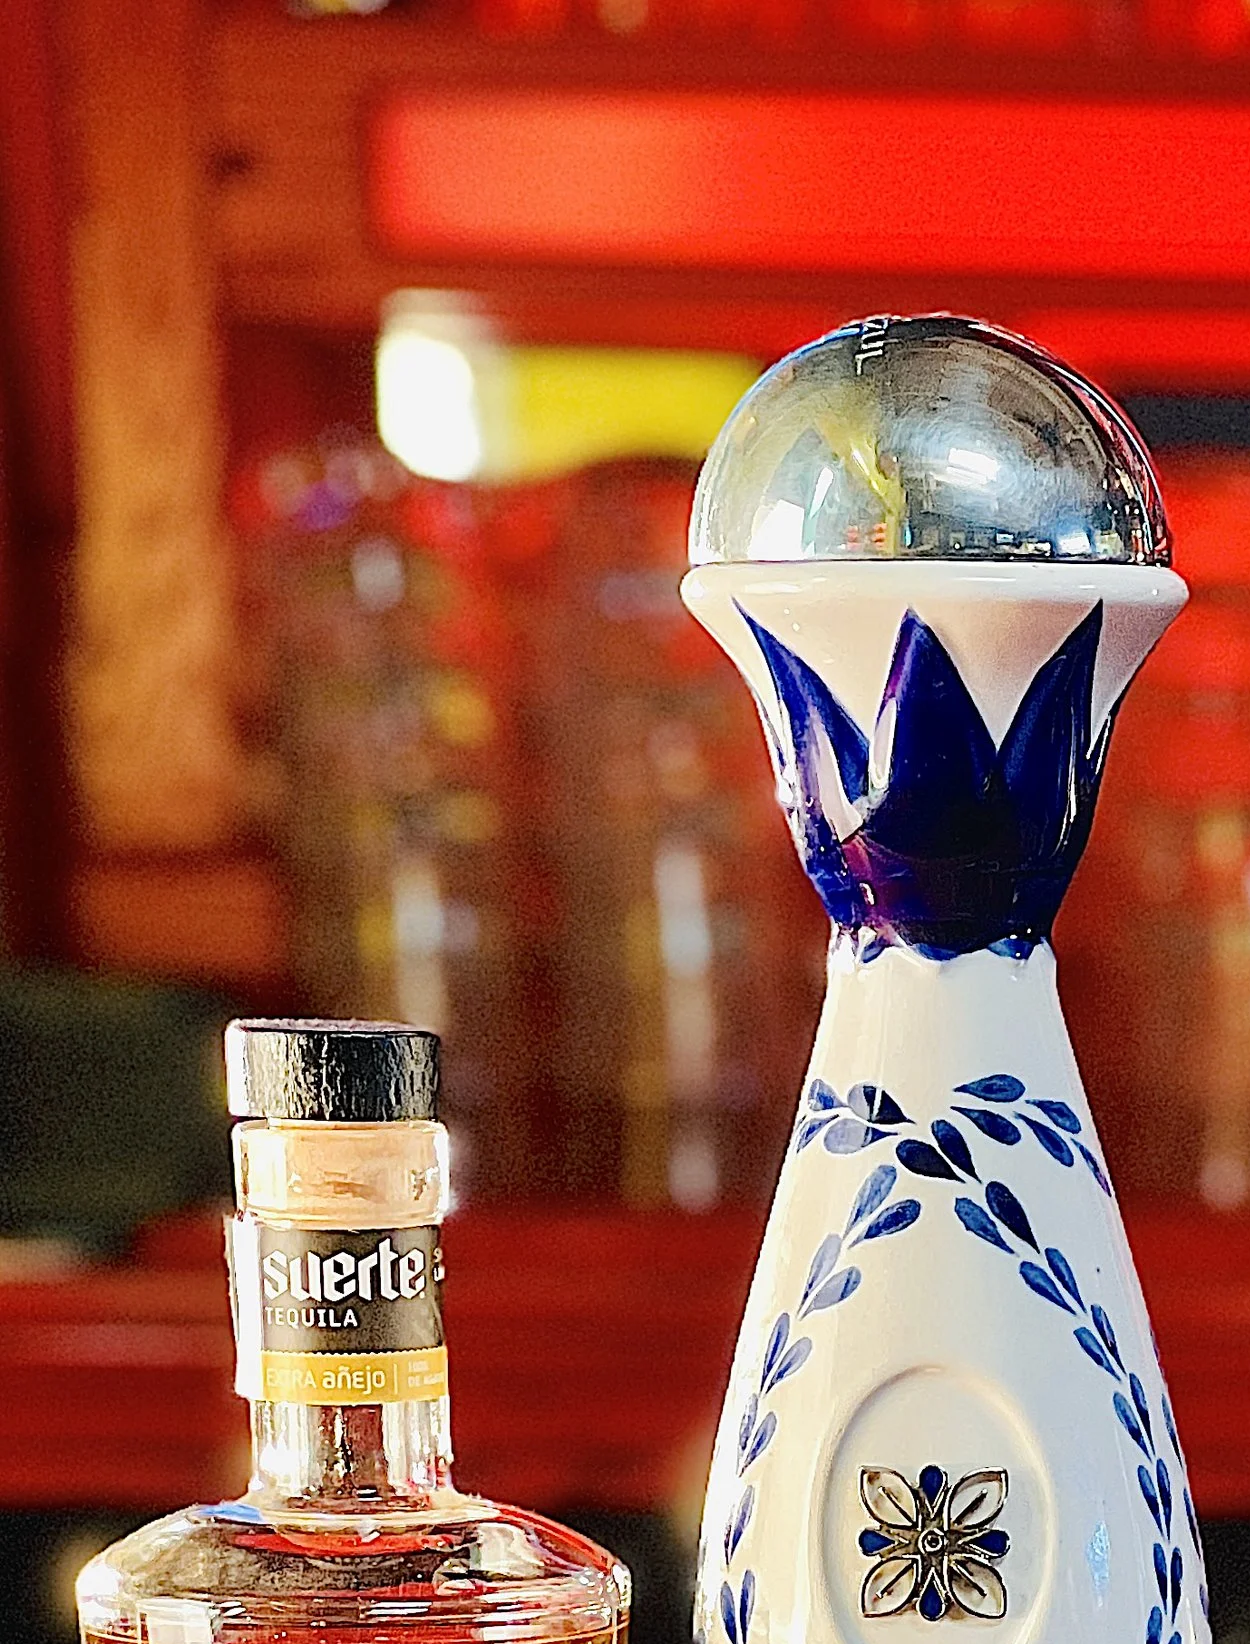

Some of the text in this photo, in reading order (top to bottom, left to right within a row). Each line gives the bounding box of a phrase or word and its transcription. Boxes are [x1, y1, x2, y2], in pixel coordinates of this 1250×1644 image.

[263, 1238, 427, 1302] suerte
[265, 1306, 358, 1330] TEQUILA
[322, 1365, 387, 1395] añejo
